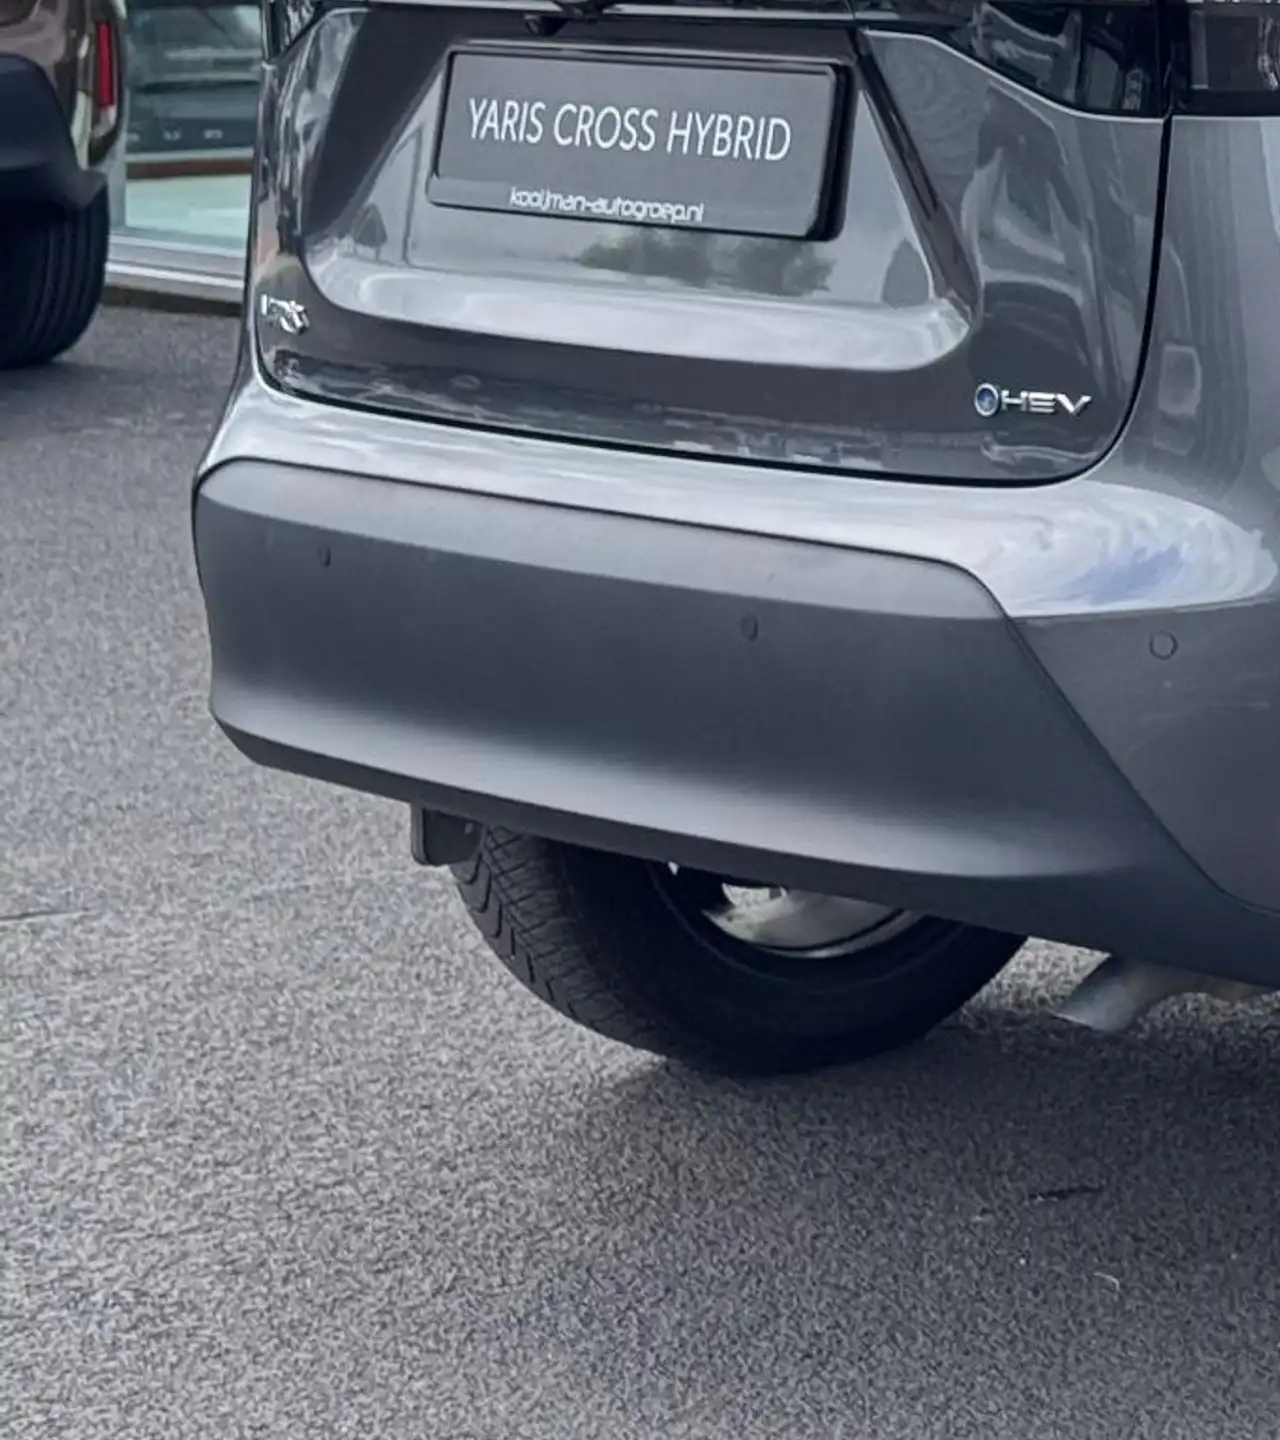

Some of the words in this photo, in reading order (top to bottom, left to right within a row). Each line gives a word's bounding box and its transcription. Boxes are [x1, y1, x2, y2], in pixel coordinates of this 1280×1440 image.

[468, 97, 547, 144] YARIS
[553, 103, 660, 152] CROSS
[666, 110, 792, 161] HYBRID
[509, 185, 704, 223] kooijman-autogroep.nl
[1001, 389, 1092, 414] HEV
